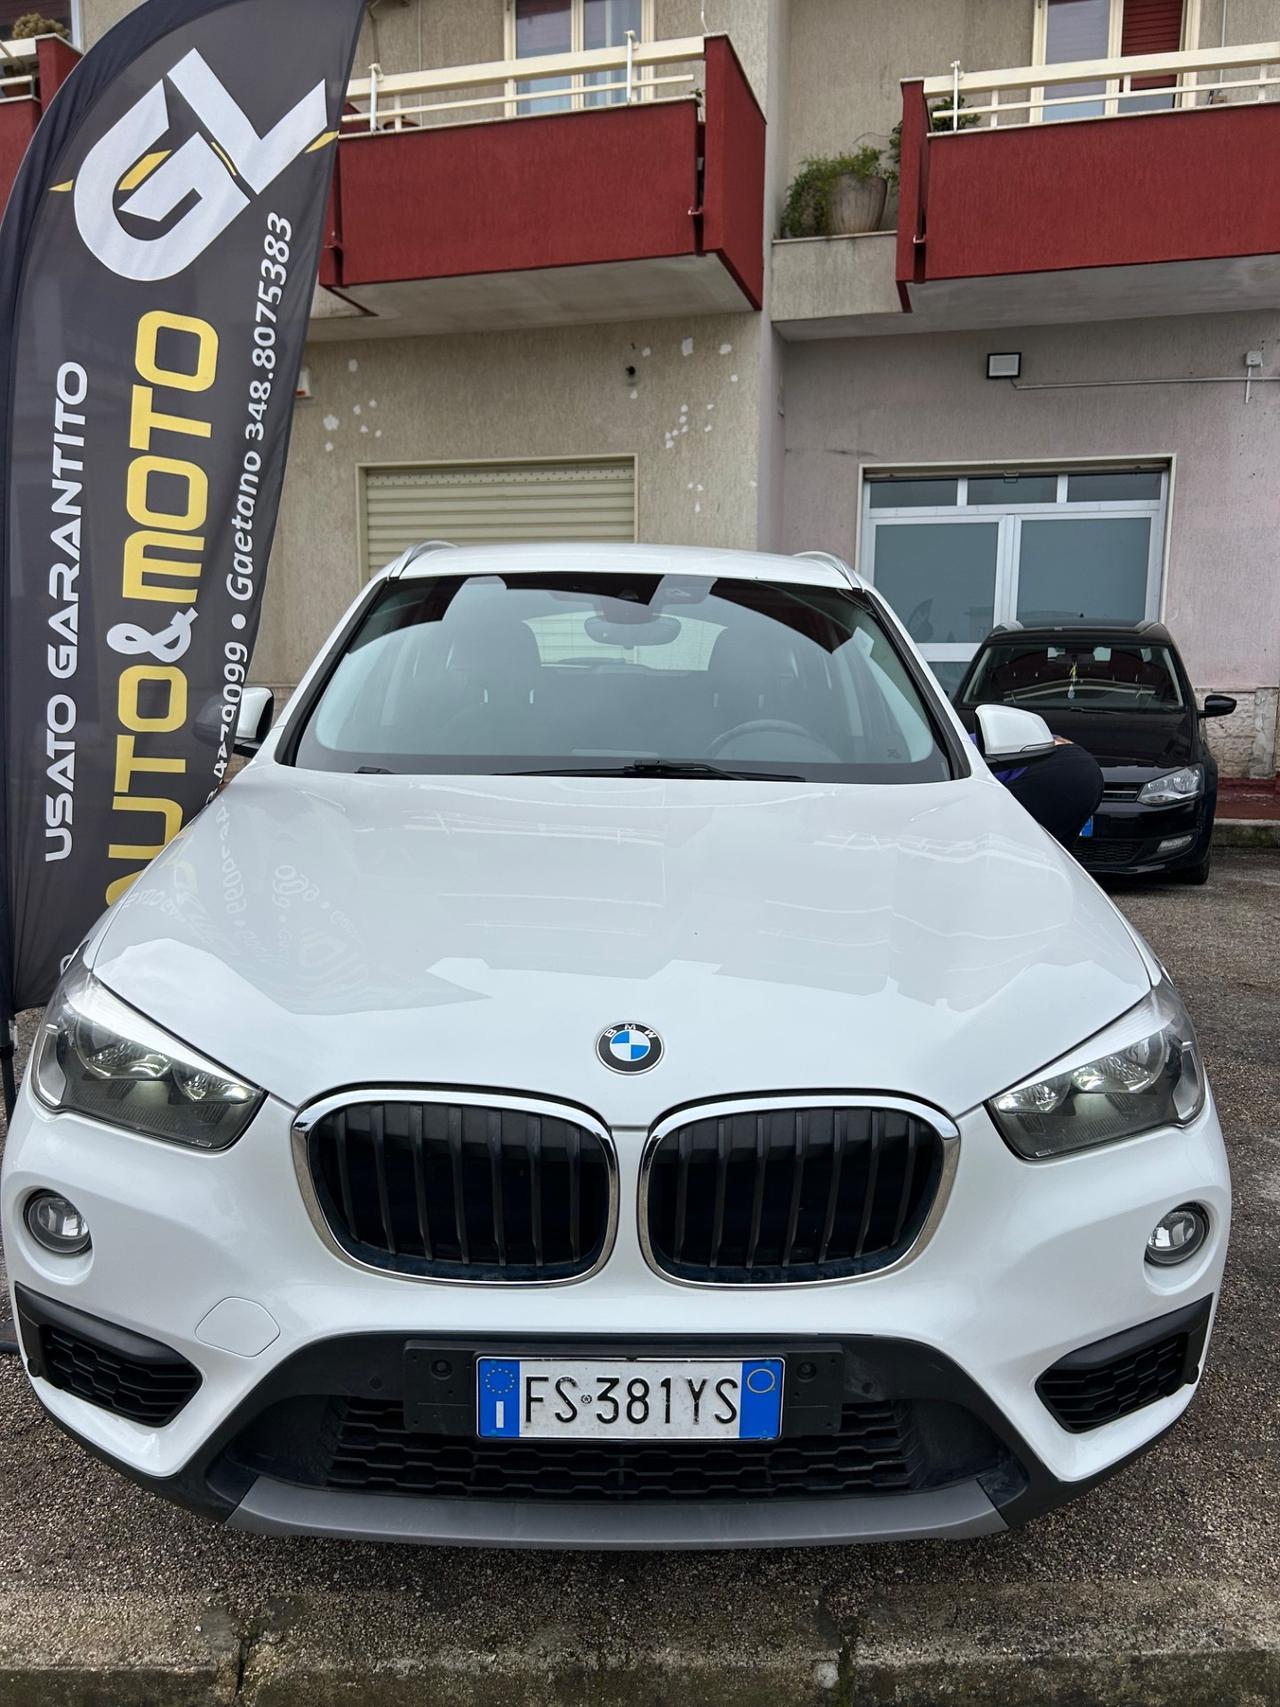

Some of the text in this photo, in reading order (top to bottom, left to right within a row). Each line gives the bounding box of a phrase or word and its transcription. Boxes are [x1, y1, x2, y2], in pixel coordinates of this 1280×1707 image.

[226, 451, 262, 600] Gaetano
[245, 211, 292, 441] 348.8075383
[45, 361, 88, 862] USATO GARANTITO
[604, 1024, 657, 1038] BMW
